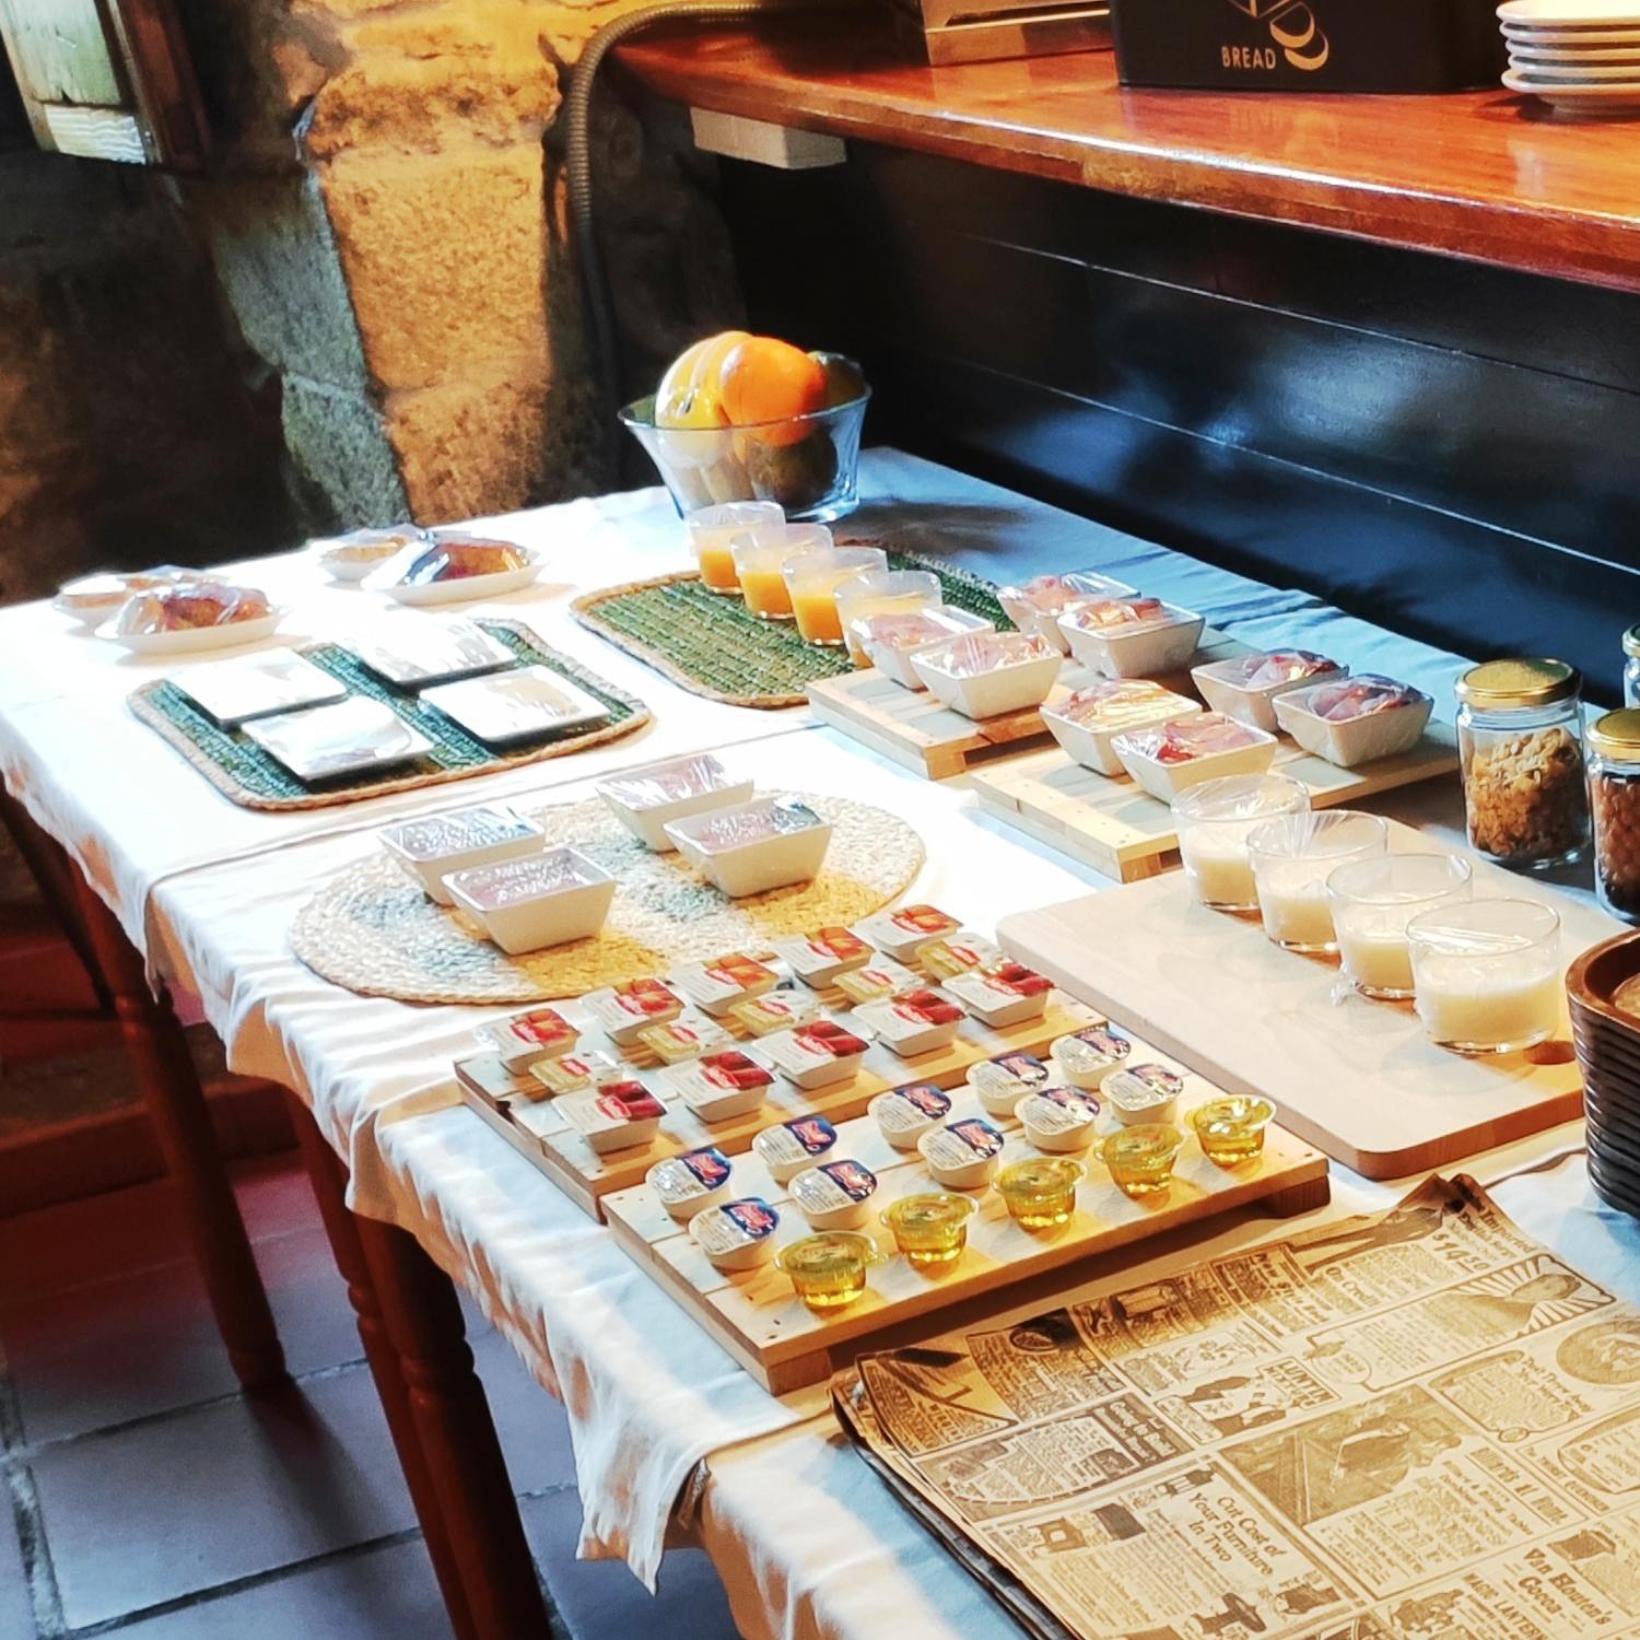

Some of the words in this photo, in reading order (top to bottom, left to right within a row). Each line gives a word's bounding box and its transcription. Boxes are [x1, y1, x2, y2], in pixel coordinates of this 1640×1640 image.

[1221, 46, 1276, 70] BREAD
[1187, 1492, 1222, 1522] Your
[1213, 1520, 1278, 1577] Furniture
[1187, 1519, 1208, 1535] In
[1200, 1532, 1237, 1563] Two
[1215, 1495, 1245, 1518] Cut
[1235, 1516, 1272, 1545] Cost
[1262, 1542, 1288, 1558] of
[1460, 1571, 1500, 1600] MAGIC
[1516, 1574, 1564, 1614] Cocoa
[1522, 1547, 1558, 1574] Van
[1547, 1572, 1618, 1626] Houten's
